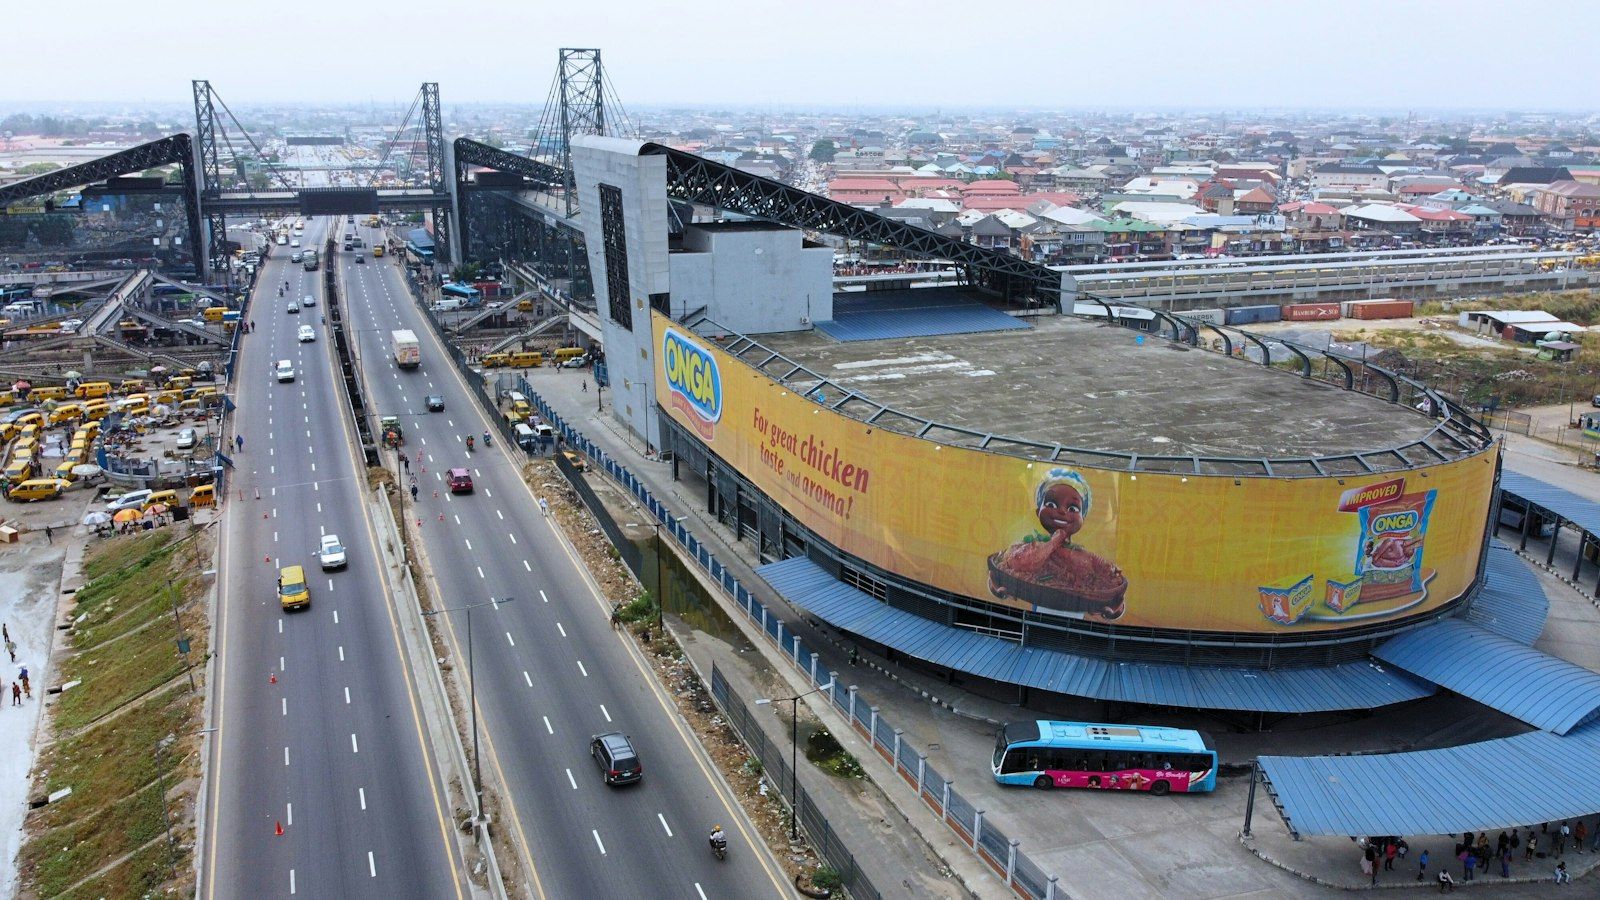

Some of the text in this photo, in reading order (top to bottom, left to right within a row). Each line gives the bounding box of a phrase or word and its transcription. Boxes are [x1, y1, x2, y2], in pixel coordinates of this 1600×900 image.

[666, 337, 716, 411] ONGA
[753, 407, 769, 435] For
[770, 424, 798, 457] great
[800, 434, 869, 494] chicken
[760, 441, 854, 520] taste and aroma!
[1345, 484, 1398, 506] IMPROVED
[1375, 513, 1414, 532] ONGA
